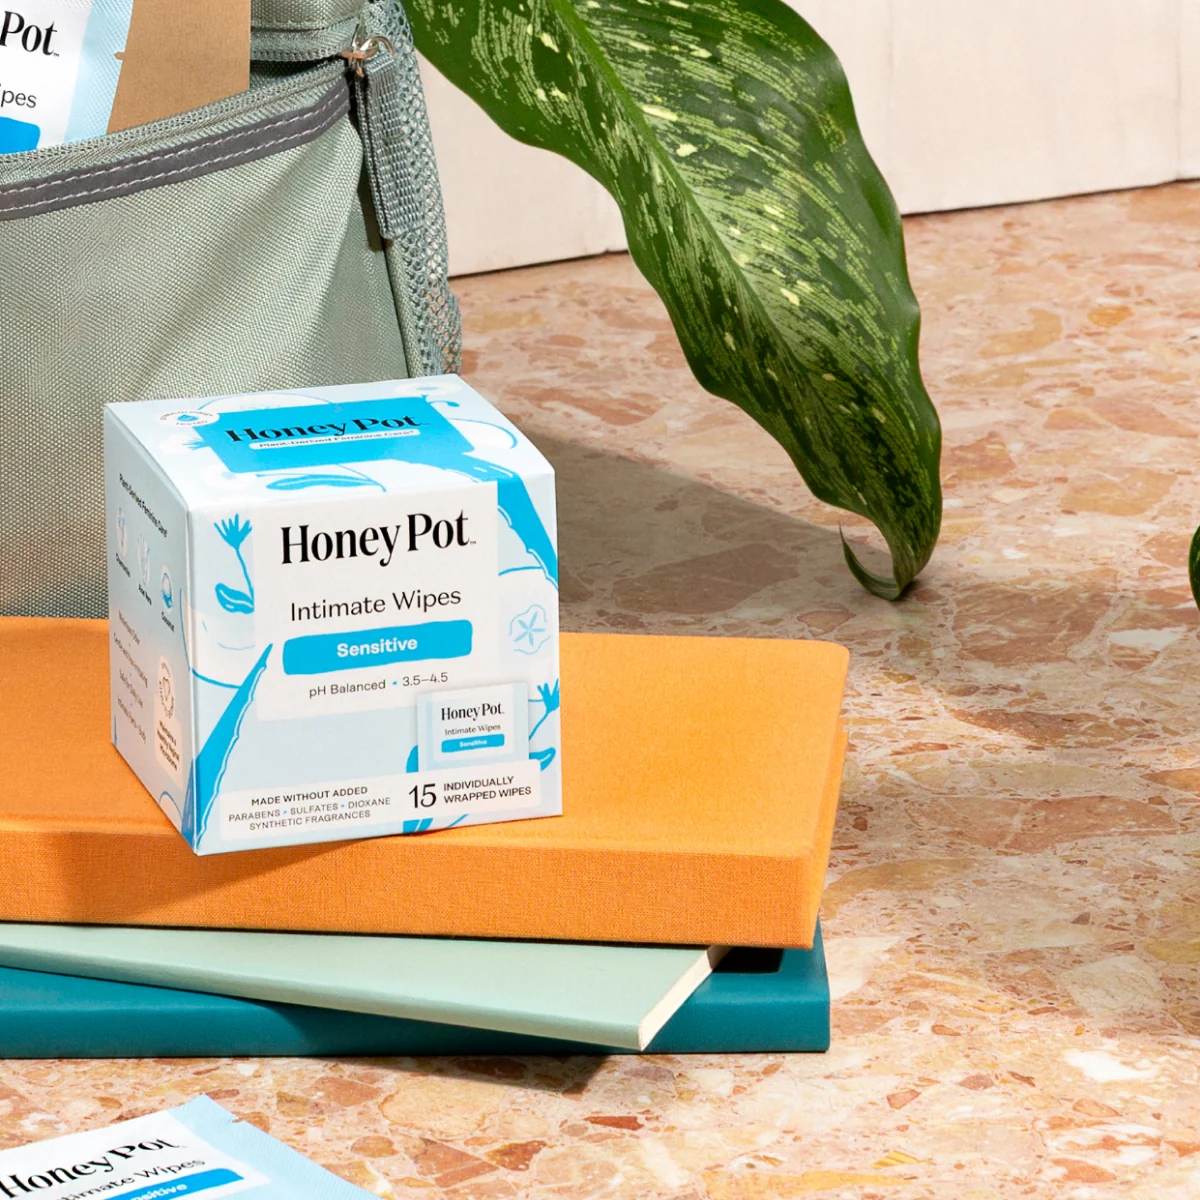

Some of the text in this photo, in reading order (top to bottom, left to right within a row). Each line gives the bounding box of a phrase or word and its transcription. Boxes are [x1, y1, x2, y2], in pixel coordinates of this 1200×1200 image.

[225, 423, 347, 443] Honey
[281, 524, 402, 567] Honey
[291, 589, 462, 622] Intimate Wipes
[336, 637, 418, 658] Sensitive
[309, 686, 326, 699] pH
[331, 679, 386, 695] Balanced
[441, 705, 481, 722] Honey
[445, 723, 502, 737] Intimate Wipes
[443, 776, 514, 792] INDIVIDUALLY
[251, 786, 368, 807] MADE WITHOUT ADDED
[408, 783, 437, 809] 15
[443, 786, 532, 804] WRAPPED WIPES
[228, 797, 391, 822] PARABENS SULFATES DIOXANE
[249, 810, 371, 831] SYNTHETIC FRAGRANCES
[133, 1158, 206, 1179] Wipes
